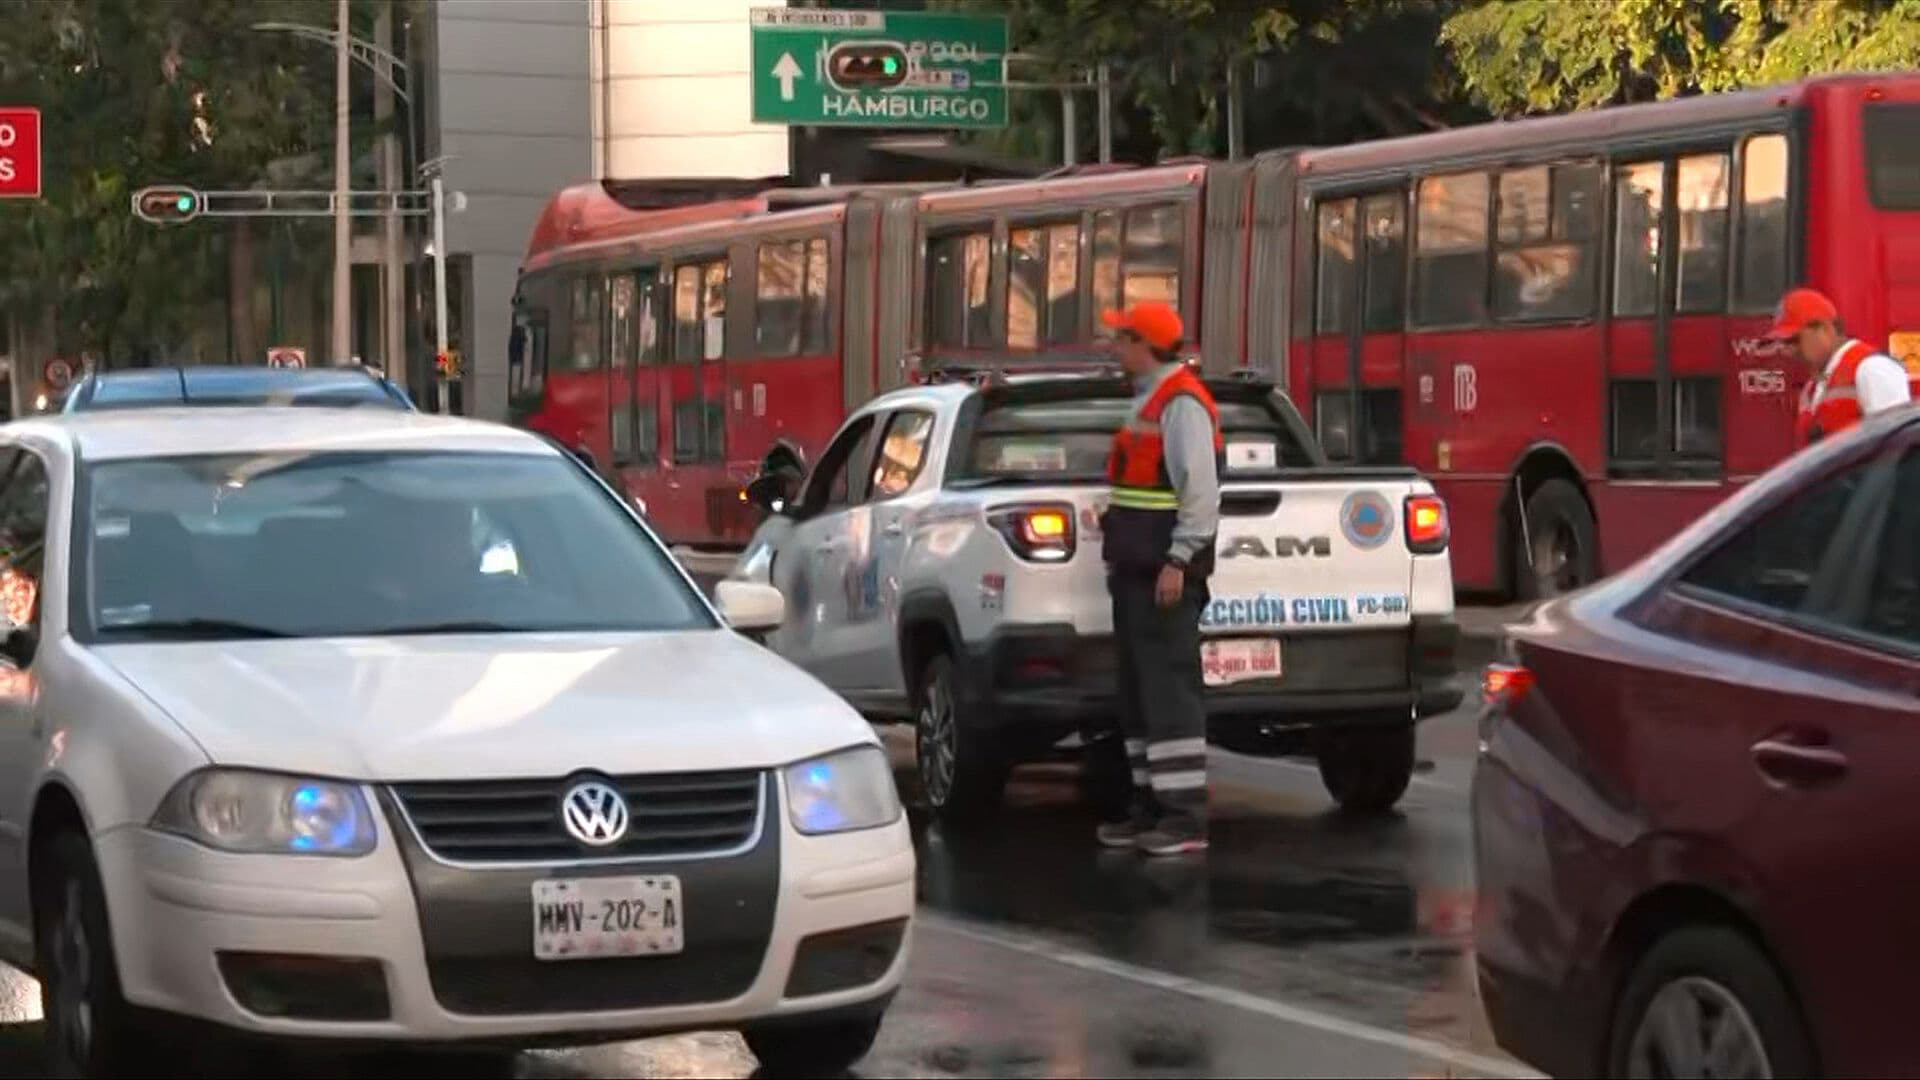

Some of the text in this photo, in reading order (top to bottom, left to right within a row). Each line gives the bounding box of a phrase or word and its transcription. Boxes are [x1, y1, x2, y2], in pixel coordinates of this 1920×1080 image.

[823, 94, 989, 119] HAMBURGO
[1218, 535, 1331, 558] AM
[1292, 597, 1351, 625] CIVIL
